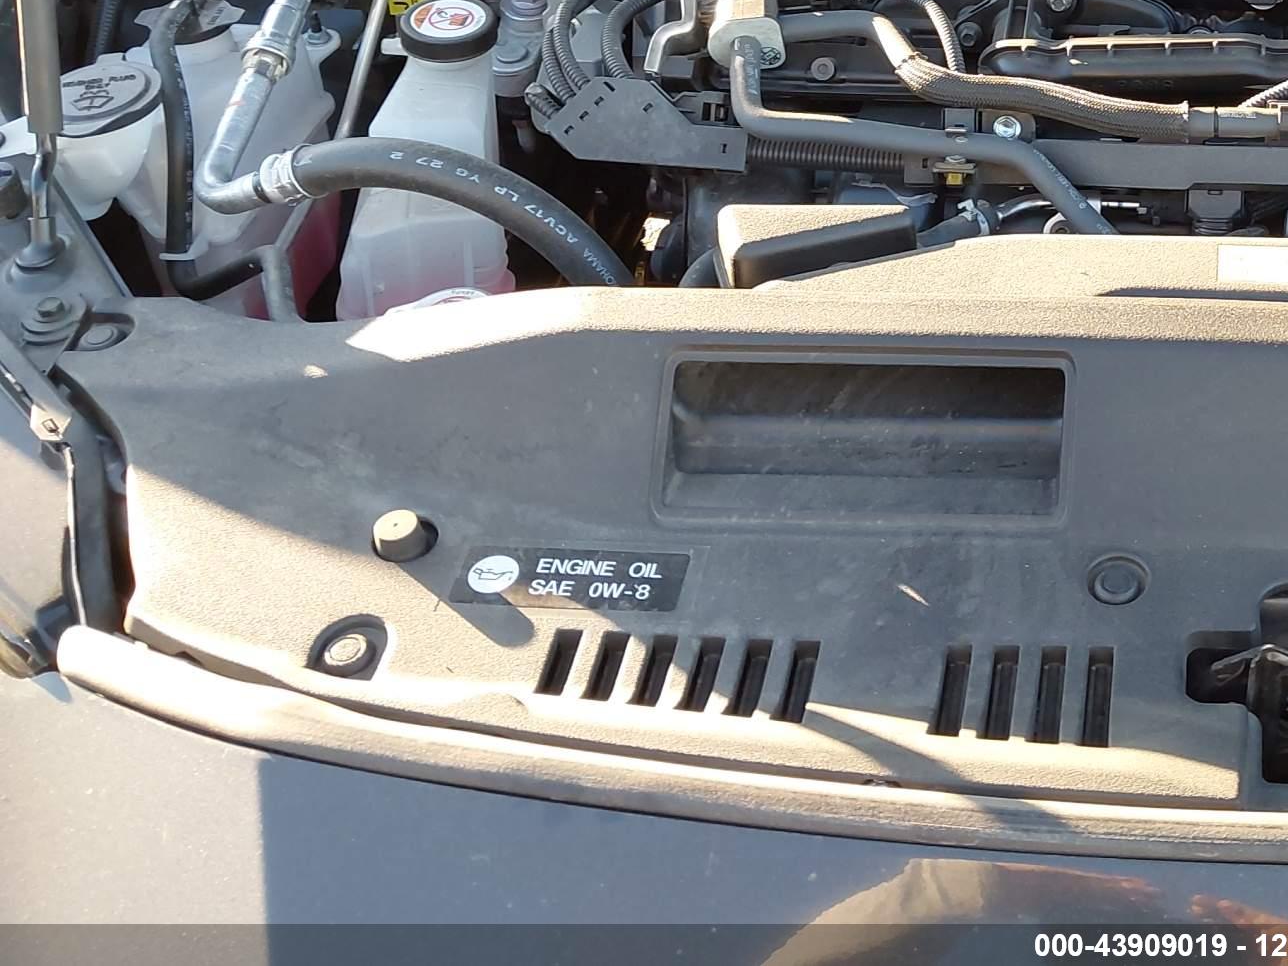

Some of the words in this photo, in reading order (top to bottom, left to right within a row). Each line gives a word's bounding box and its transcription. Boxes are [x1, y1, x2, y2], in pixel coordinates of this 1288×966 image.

[389, 151, 402, 160] 2
[415, 156, 443, 169] 27
[493, 186, 520, 203] LP
[524, 204, 578, 244] ACV17
[535, 558, 616, 577] ENGINE
[628, 561, 662, 579] OIL
[528, 579, 575, 597] SAE
[588, 582, 651, 600] 0W-8
